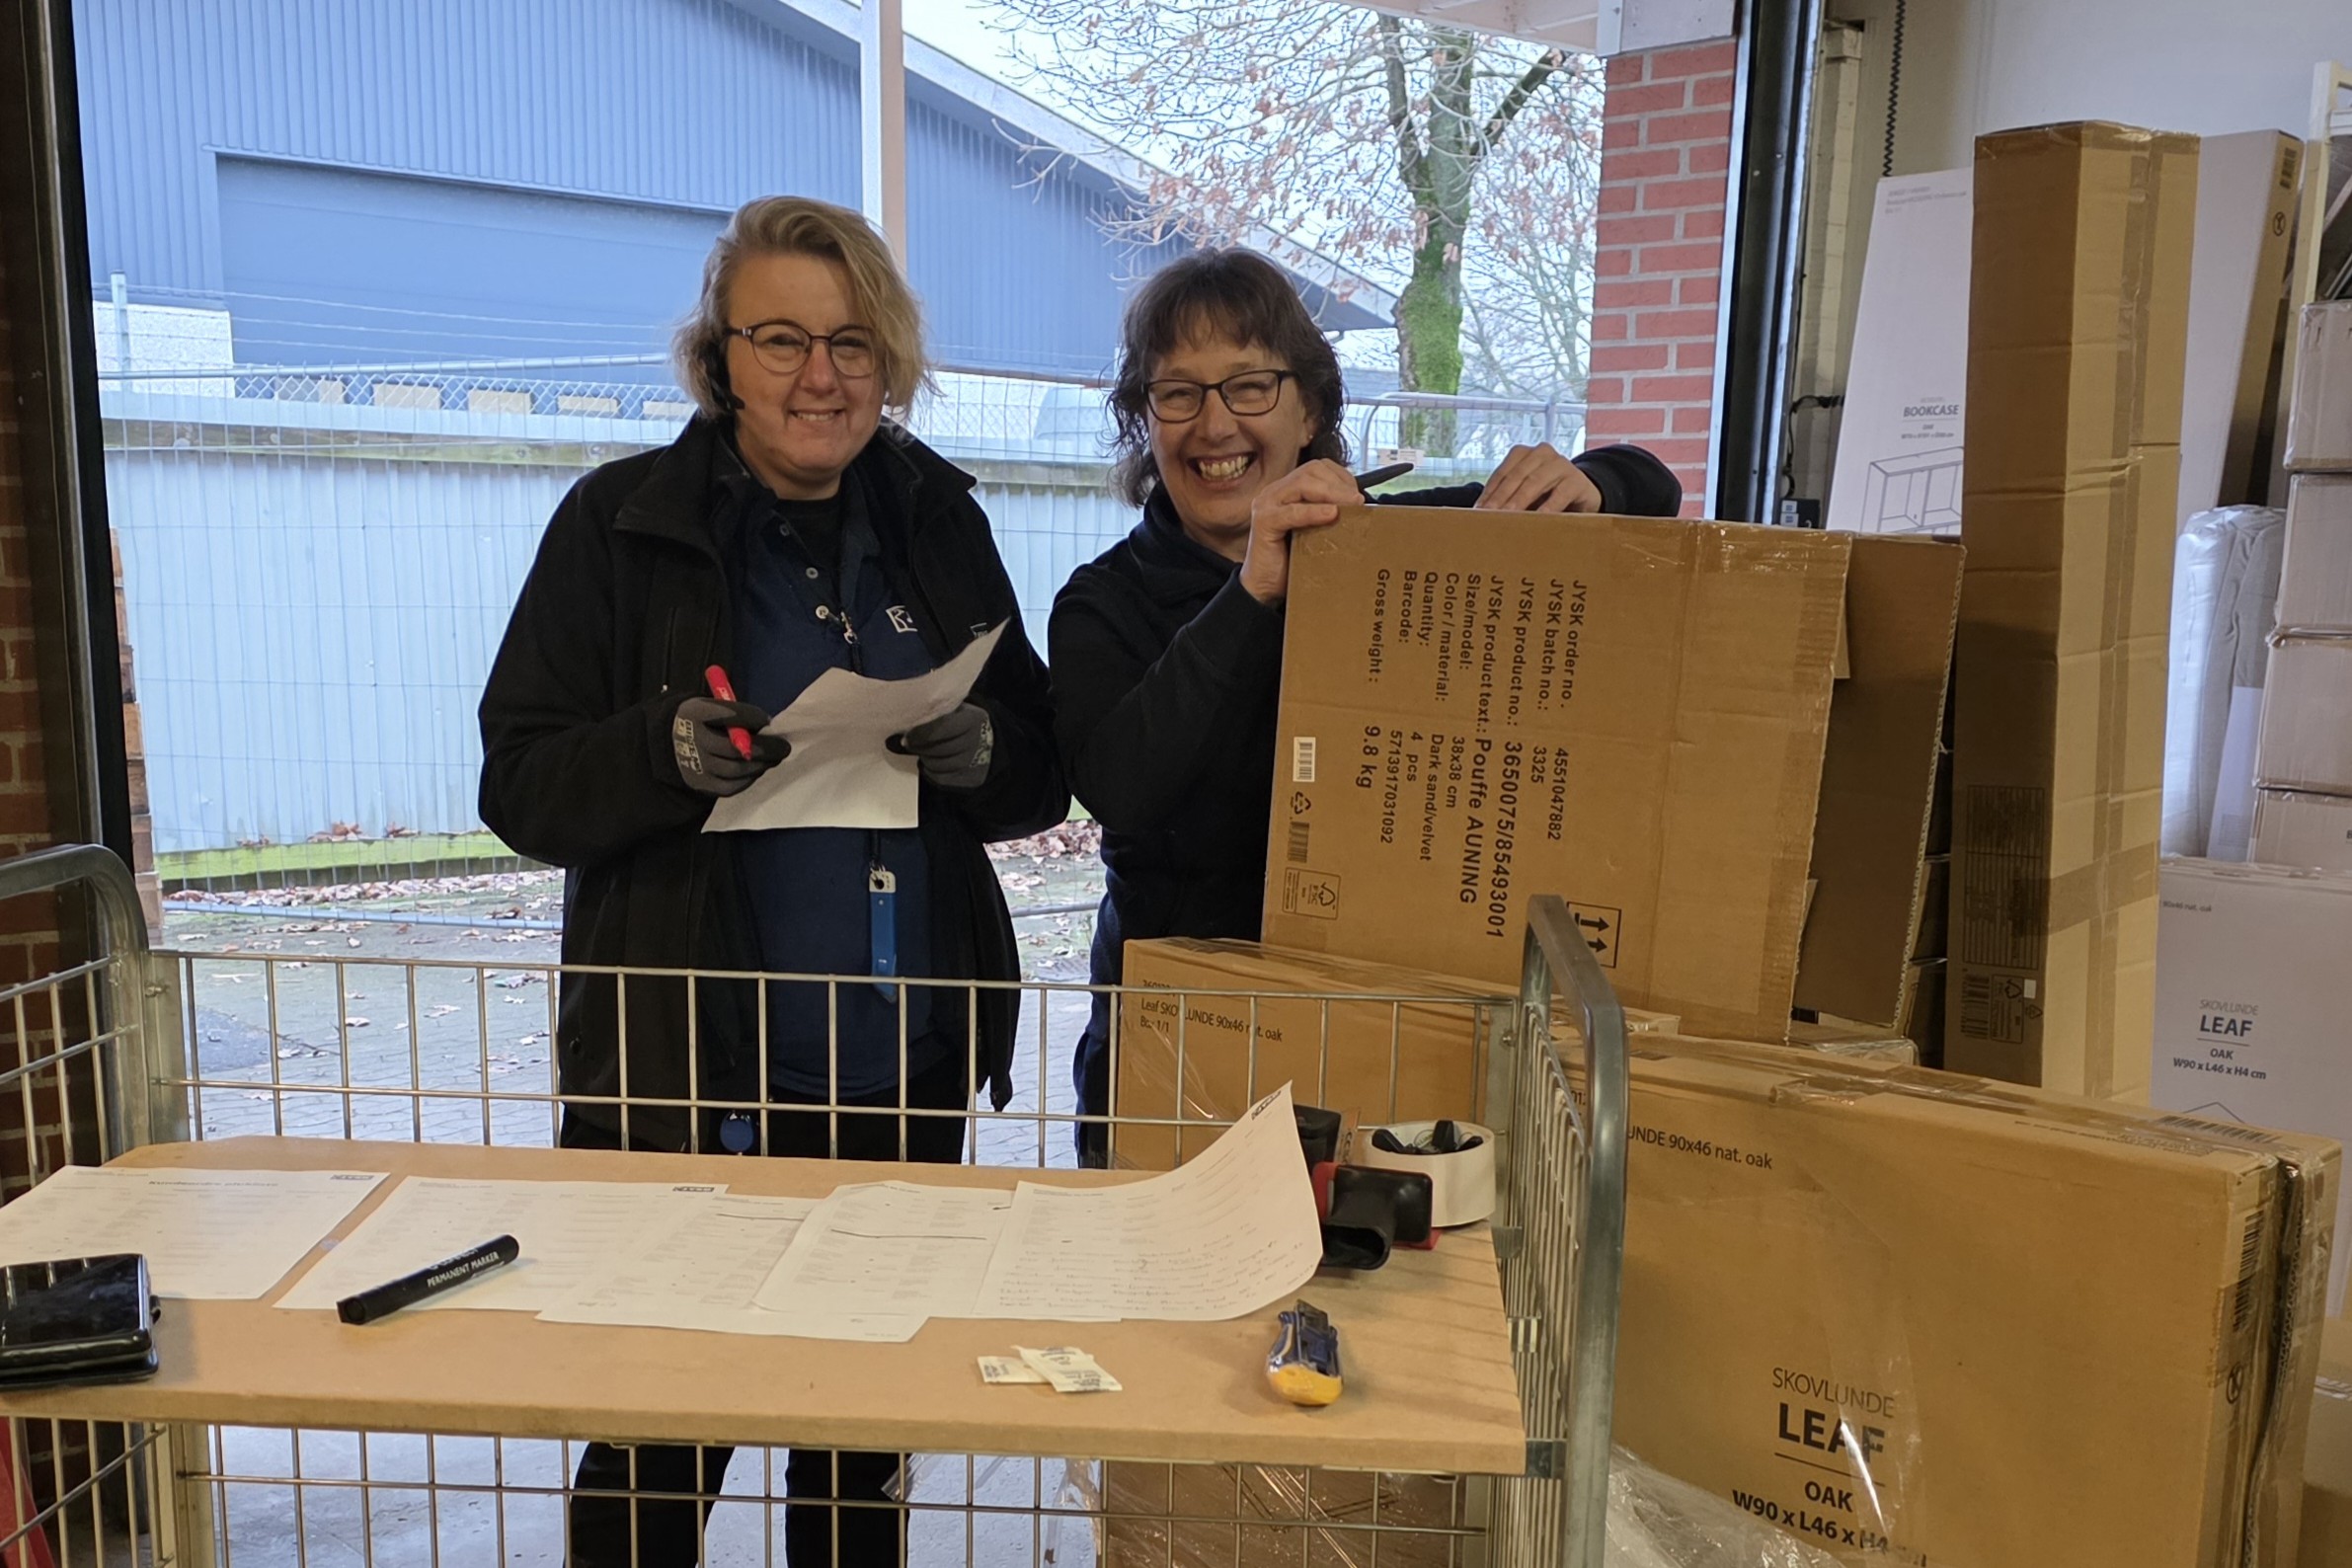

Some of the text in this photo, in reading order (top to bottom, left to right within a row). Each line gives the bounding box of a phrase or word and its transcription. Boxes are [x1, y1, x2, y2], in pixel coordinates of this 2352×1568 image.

[1903, 404, 1959, 417] BOOKCASE
[1373, 569, 1390, 616] Gross
[1398, 571, 1417, 643] Barcode:
[1417, 572, 1438, 646] Quantity:
[1442, 573, 1458, 618] Color
[1568, 581, 1587, 625] JYSK
[1458, 574, 1480, 670] Size/model:
[1537, 579, 1564, 710] JYSK batch no.:
[1435, 630, 1452, 702] material:
[1476, 576, 1504, 733] JYSK product text.:
[1507, 578, 1534, 727] JYSK product no.:
[1564, 630, 1579, 675] order
[1356, 726, 1380, 789] 9.8 kg
[1405, 732, 1422, 782] 4 pcs
[1446, 737, 1464, 808] 38x38 cm
[1530, 746, 1546, 783] 3325
[1379, 730, 1402, 843] 5713917031092
[1419, 734, 1443, 861] Dark sand/velvet
[1547, 747, 1569, 840] 4551047882
[1459, 739, 1491, 903] Pouffe AUNING
[1486, 742, 1523, 938] 3650075/85493001
[1141, 997, 1159, 1012] Leaf
[1160, 1002, 1215, 1026] SKOUNDE
[1216, 1015, 1244, 1033] 90x46
[1265, 1028, 1283, 1043] oak
[1157, 1020, 1169, 1033] 1/1
[2200, 1015, 2253, 1037] LEAF
[2173, 1058, 2196, 1069] W90
[2206, 1062, 2225, 1073] L46
[2234, 1066, 2249, 1077] H4
[2251, 1070, 2267, 1079] cm
[2210, 1049, 2234, 1060] OAK
[1669, 1135, 1712, 1156] 90x46
[1715, 1145, 1742, 1163] nat.
[1746, 1153, 1773, 1169] oak
[427, 1263, 471, 1288] PERMANENT
[471, 1251, 500, 1270] MARKER
[1772, 1368, 1895, 1418] SKOVLUNDE
[1778, 1402, 1885, 1463] LEAF
[1732, 1489, 1778, 1521] W90
[1781, 1509, 1795, 1527] x
[1799, 1511, 1838, 1539] L46
[1842, 1528, 1855, 1546] x
[1804, 1481, 1853, 1513] OAK
